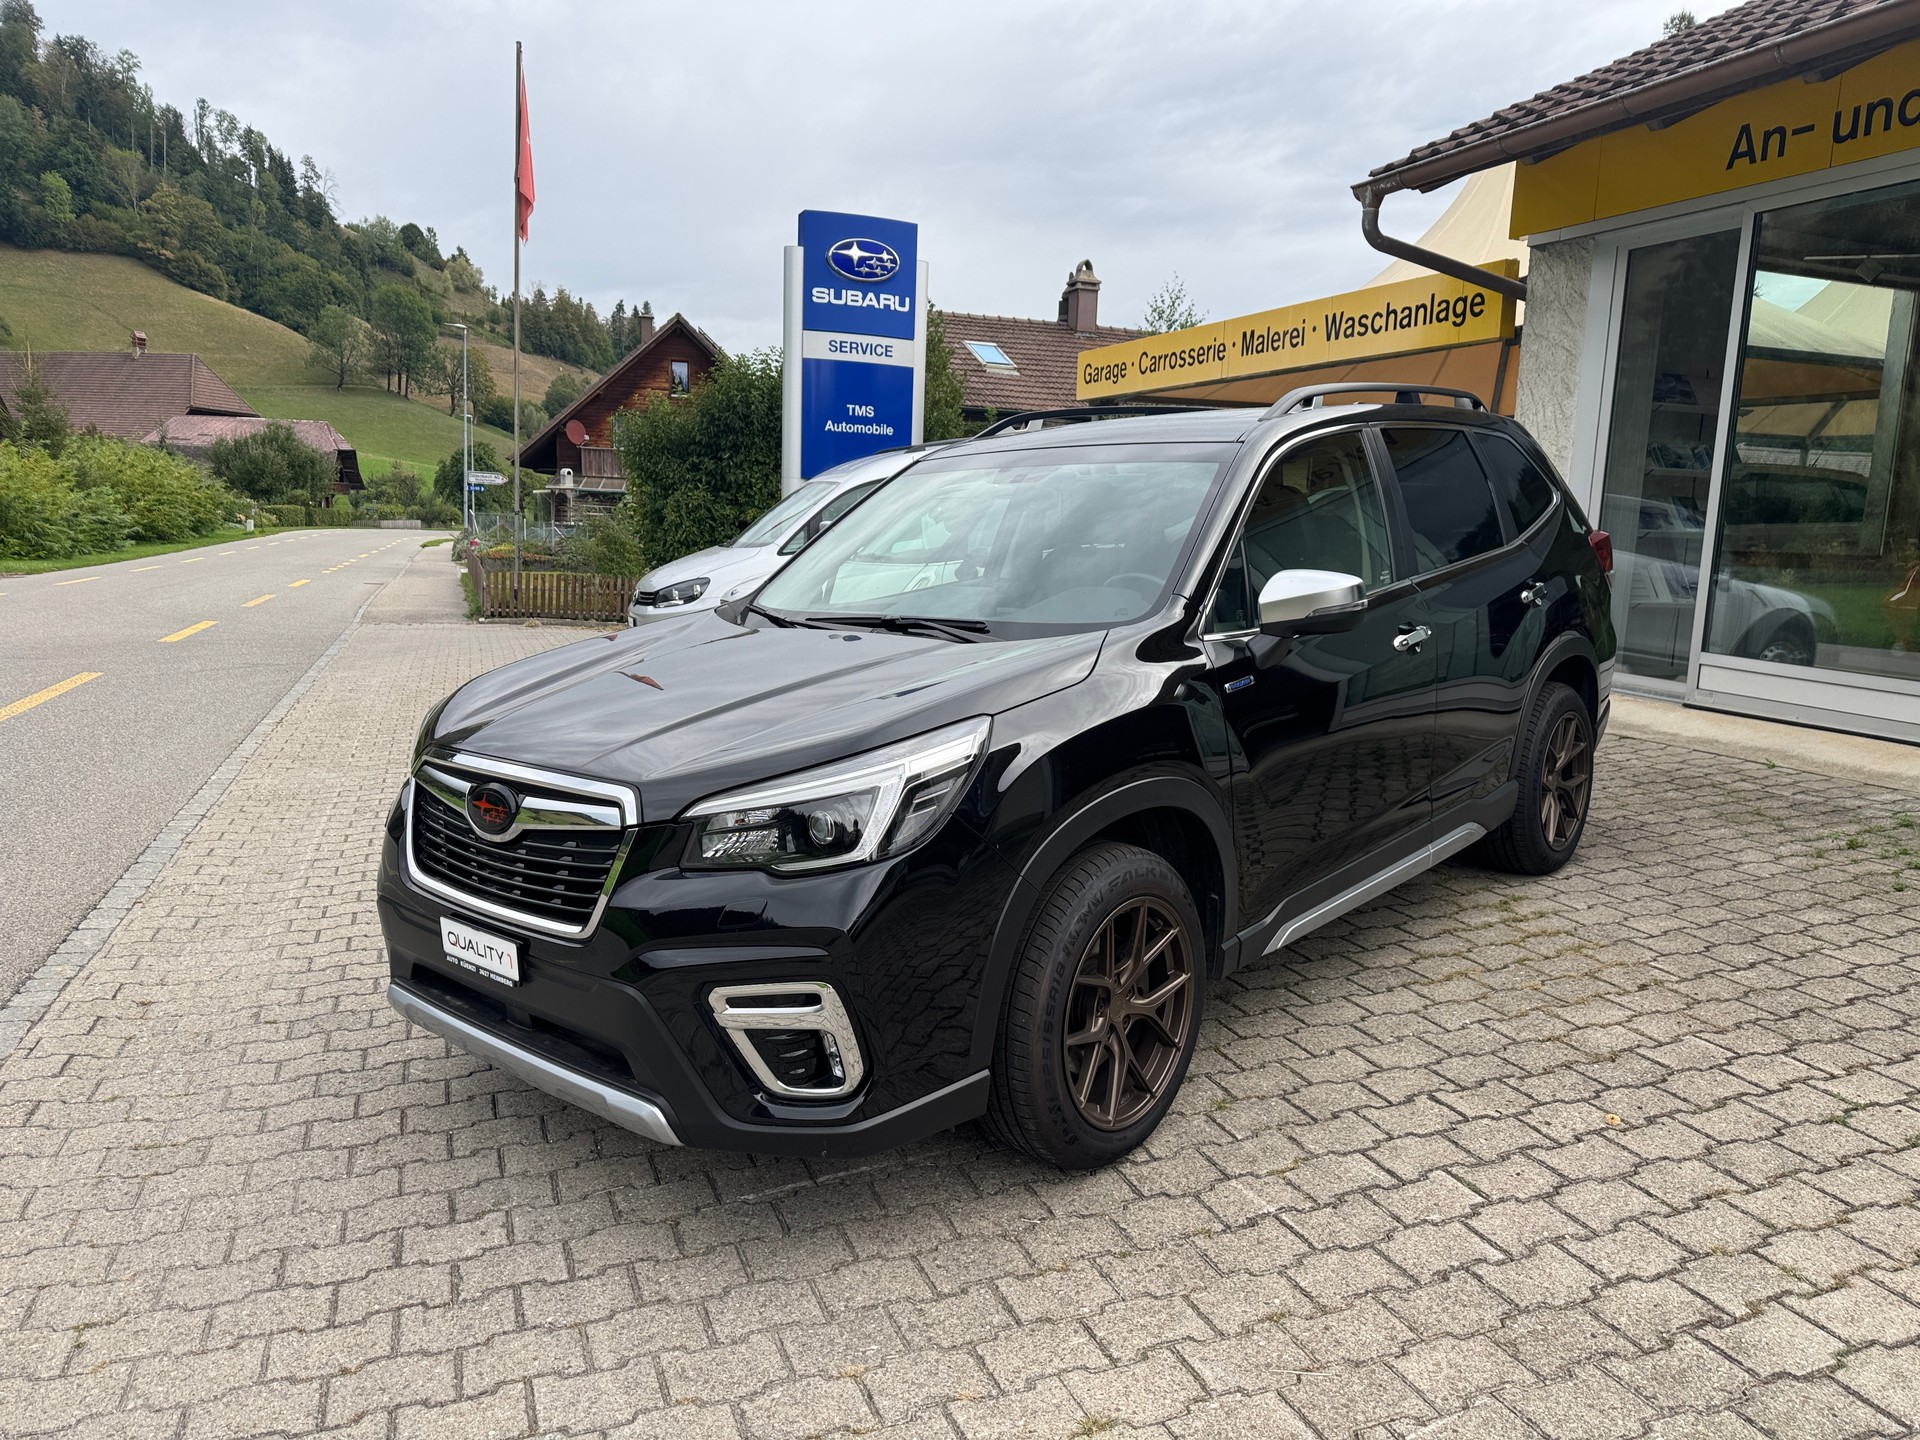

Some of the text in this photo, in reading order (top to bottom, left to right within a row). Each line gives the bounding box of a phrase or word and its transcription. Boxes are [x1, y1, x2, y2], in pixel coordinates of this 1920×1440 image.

[1726, 123, 1815, 170] An-
[811, 288, 909, 312] SUBARU
[828, 339, 893, 358] SERVICE
[1083, 291, 1486, 385] Garage Carrosserie Malerei Waschanlage
[847, 404, 875, 418] TMS
[824, 420, 894, 436] Automobile
